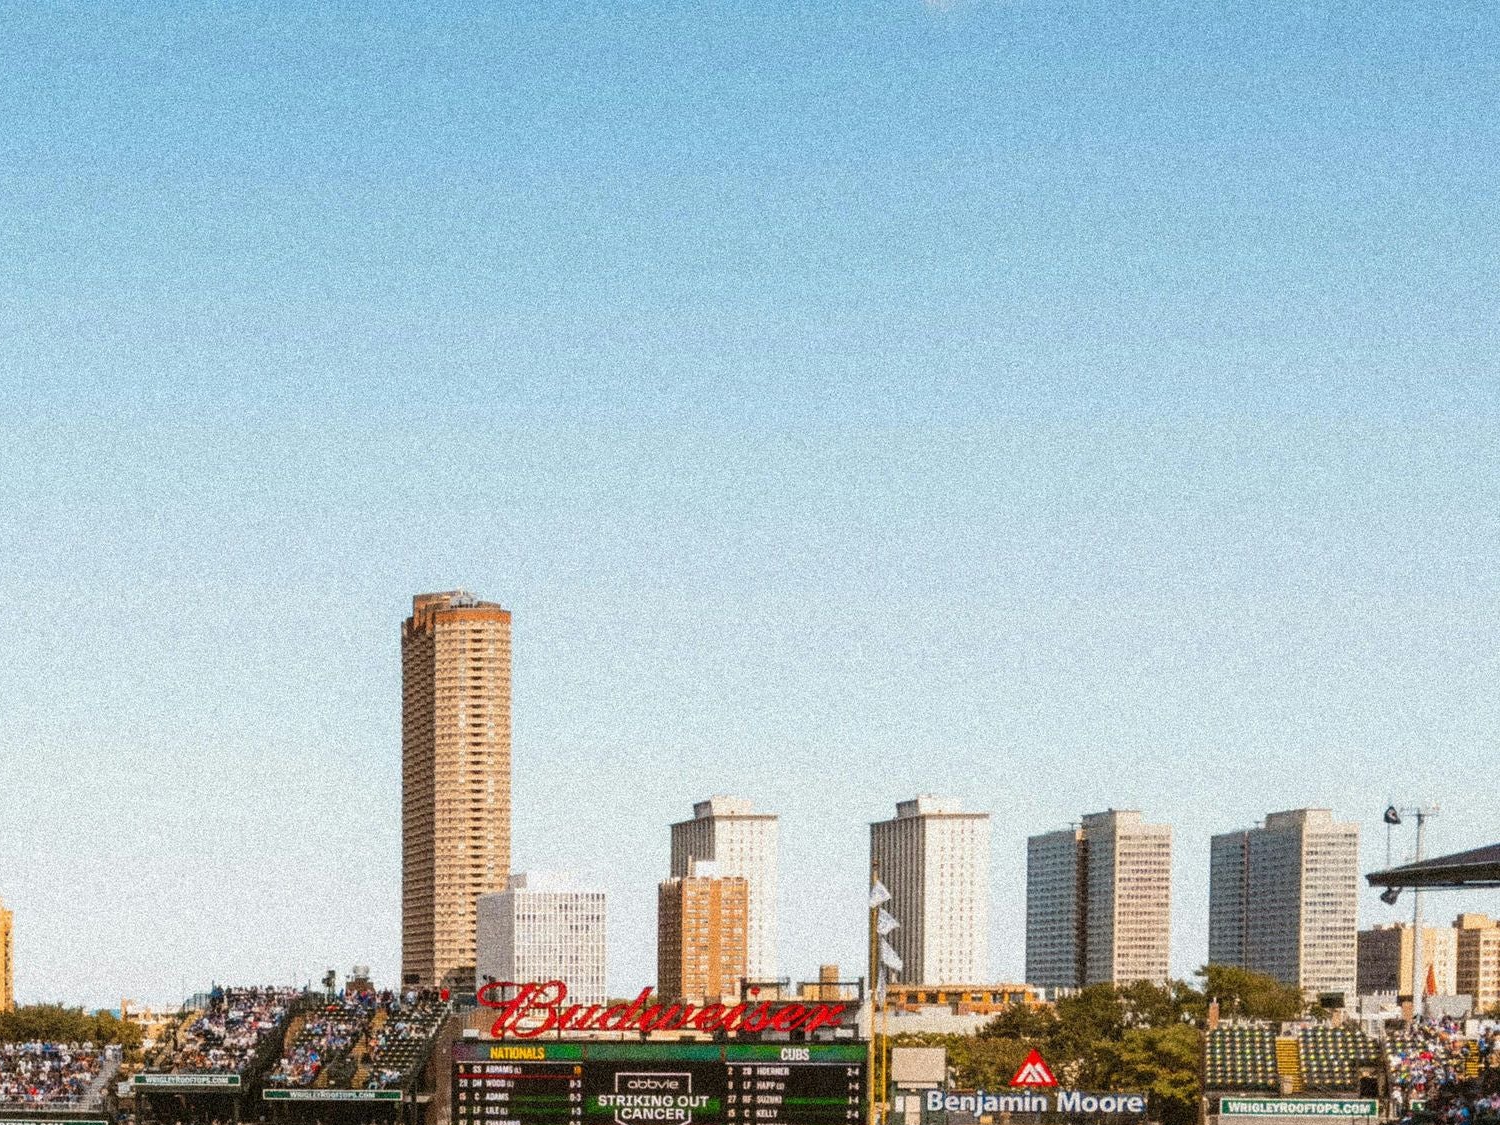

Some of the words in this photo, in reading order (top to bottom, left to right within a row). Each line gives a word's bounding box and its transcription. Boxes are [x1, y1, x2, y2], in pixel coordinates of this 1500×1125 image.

[477, 980, 849, 1040] Budweiser
[489, 1046, 545, 1060] NATIONALS
[780, 1048, 810, 1061] CUBS
[146, 1075, 229, 1085] WRIGLEYROOFTOPS.COM
[627, 1079, 679, 1090] abbvie
[756, 1081, 776, 1089] HAPP
[485, 1093, 509, 1101] ADAMS
[598, 1095, 674, 1107] STRIKING
[677, 1095, 710, 1108] OUT
[927, 1090, 1048, 1117] Benjamin
[1057, 1091, 1144, 1113] Moore
[1228, 1102, 1371, 1115] WRIGLEYROOFTOPS.COM
[621, 1108, 685, 1120] CANCER
[755, 1109, 778, 1117] KELLY
